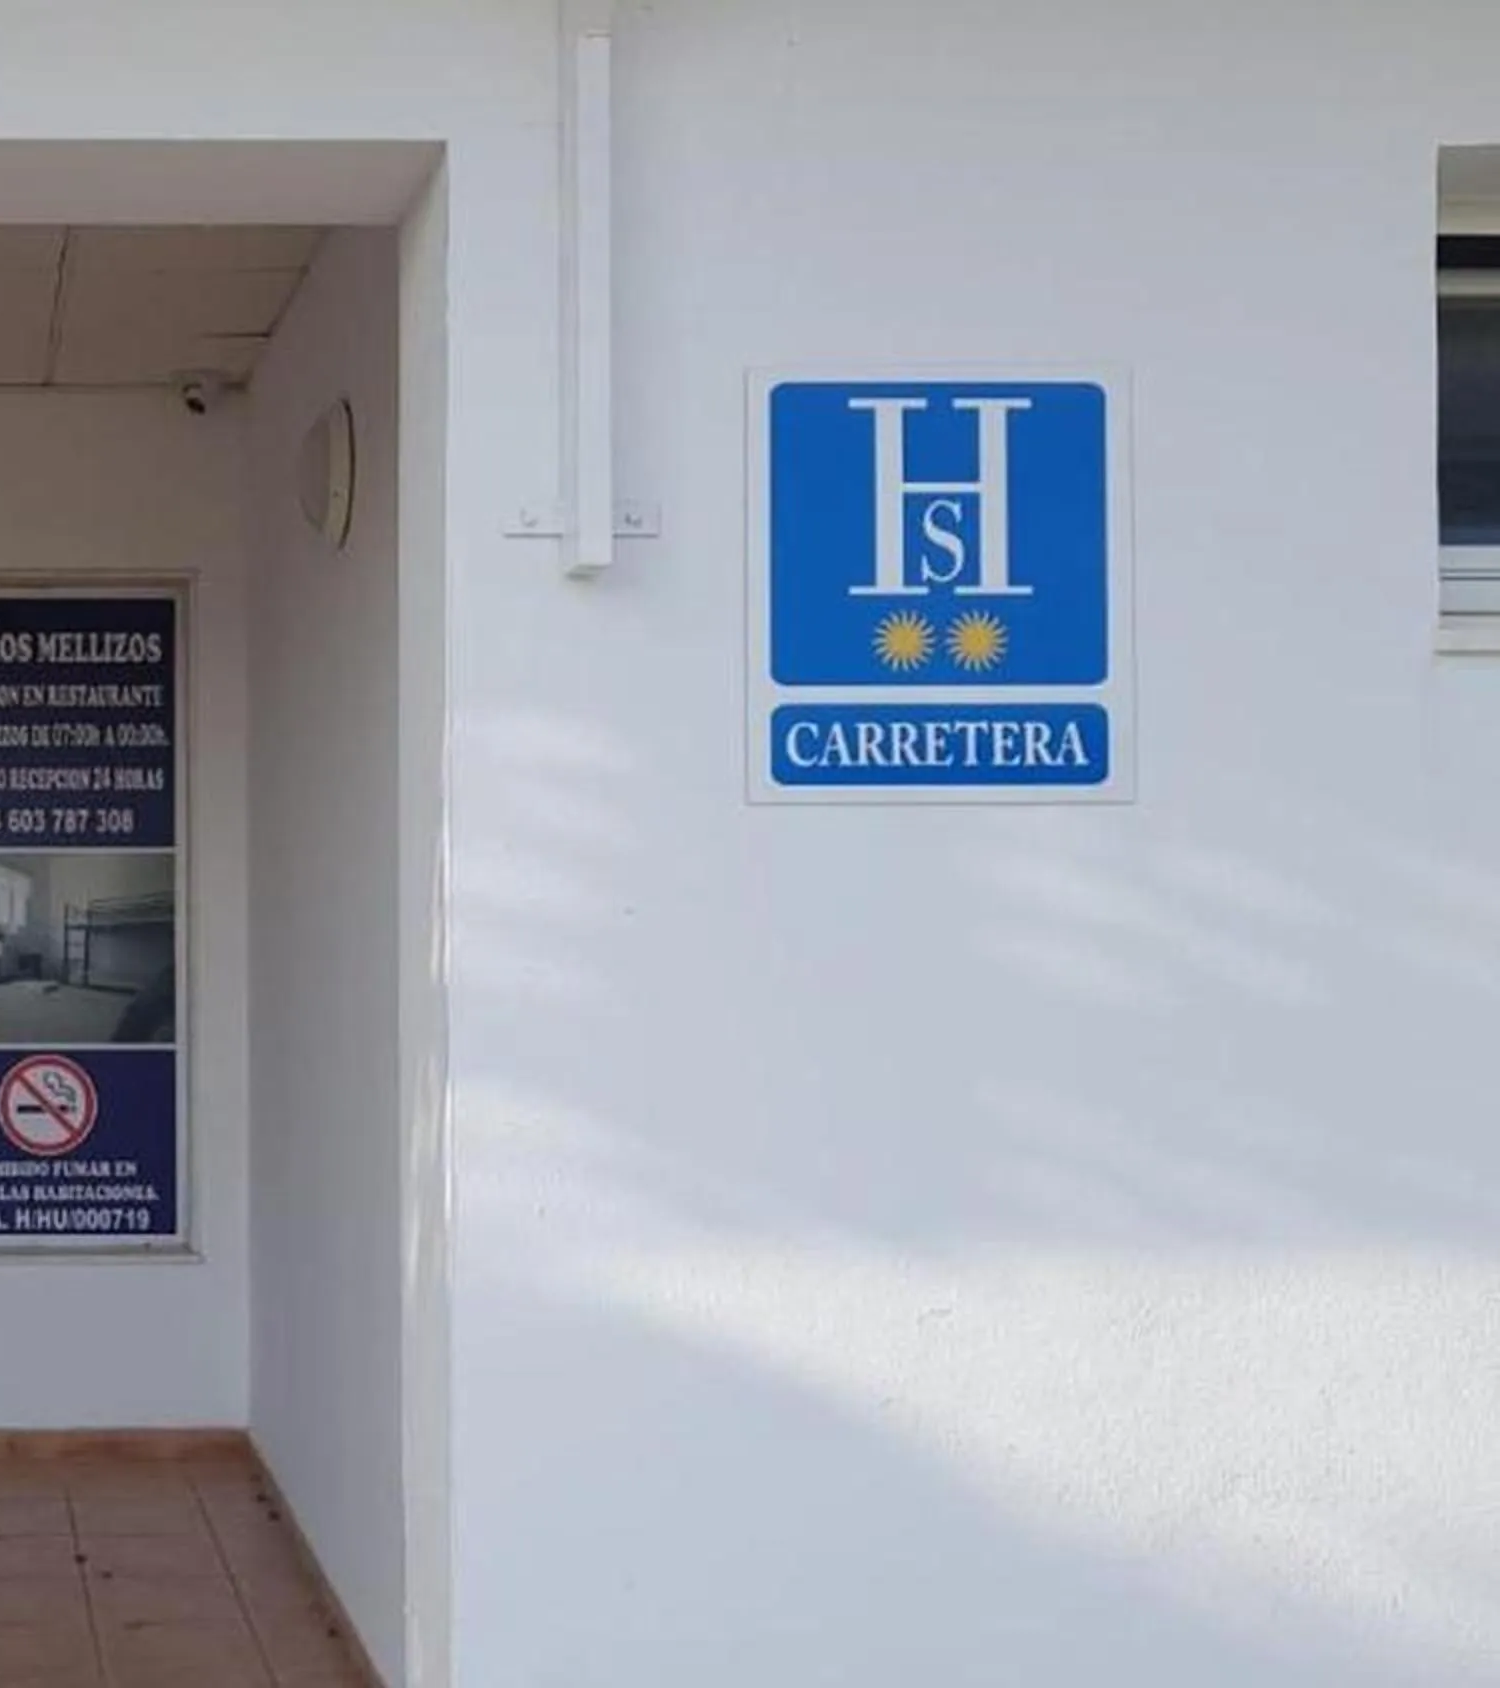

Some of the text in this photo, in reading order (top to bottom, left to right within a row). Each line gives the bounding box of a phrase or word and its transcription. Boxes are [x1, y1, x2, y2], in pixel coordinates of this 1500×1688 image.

[36, 632, 162, 663] MELLIZOS
[22, 684, 44, 707] EN
[47, 684, 164, 707] RESTAURANTE
[31, 722, 50, 747] DE
[103, 722, 115, 747] A
[786, 721, 1089, 768] CARRETERA
[9, 767, 89, 790] RECEPCION
[92, 767, 110, 790] 24
[113, 767, 164, 790] HORAS
[8, 808, 45, 833] 603
[51, 808, 89, 833] 787
[95, 808, 135, 833] 308
[52, 1160, 110, 1178] FUMAR
[114, 1160, 137, 1178] EN
[0, 1184, 30, 1201] LAS
[15, 1209, 151, 1231] H/HU/000719
